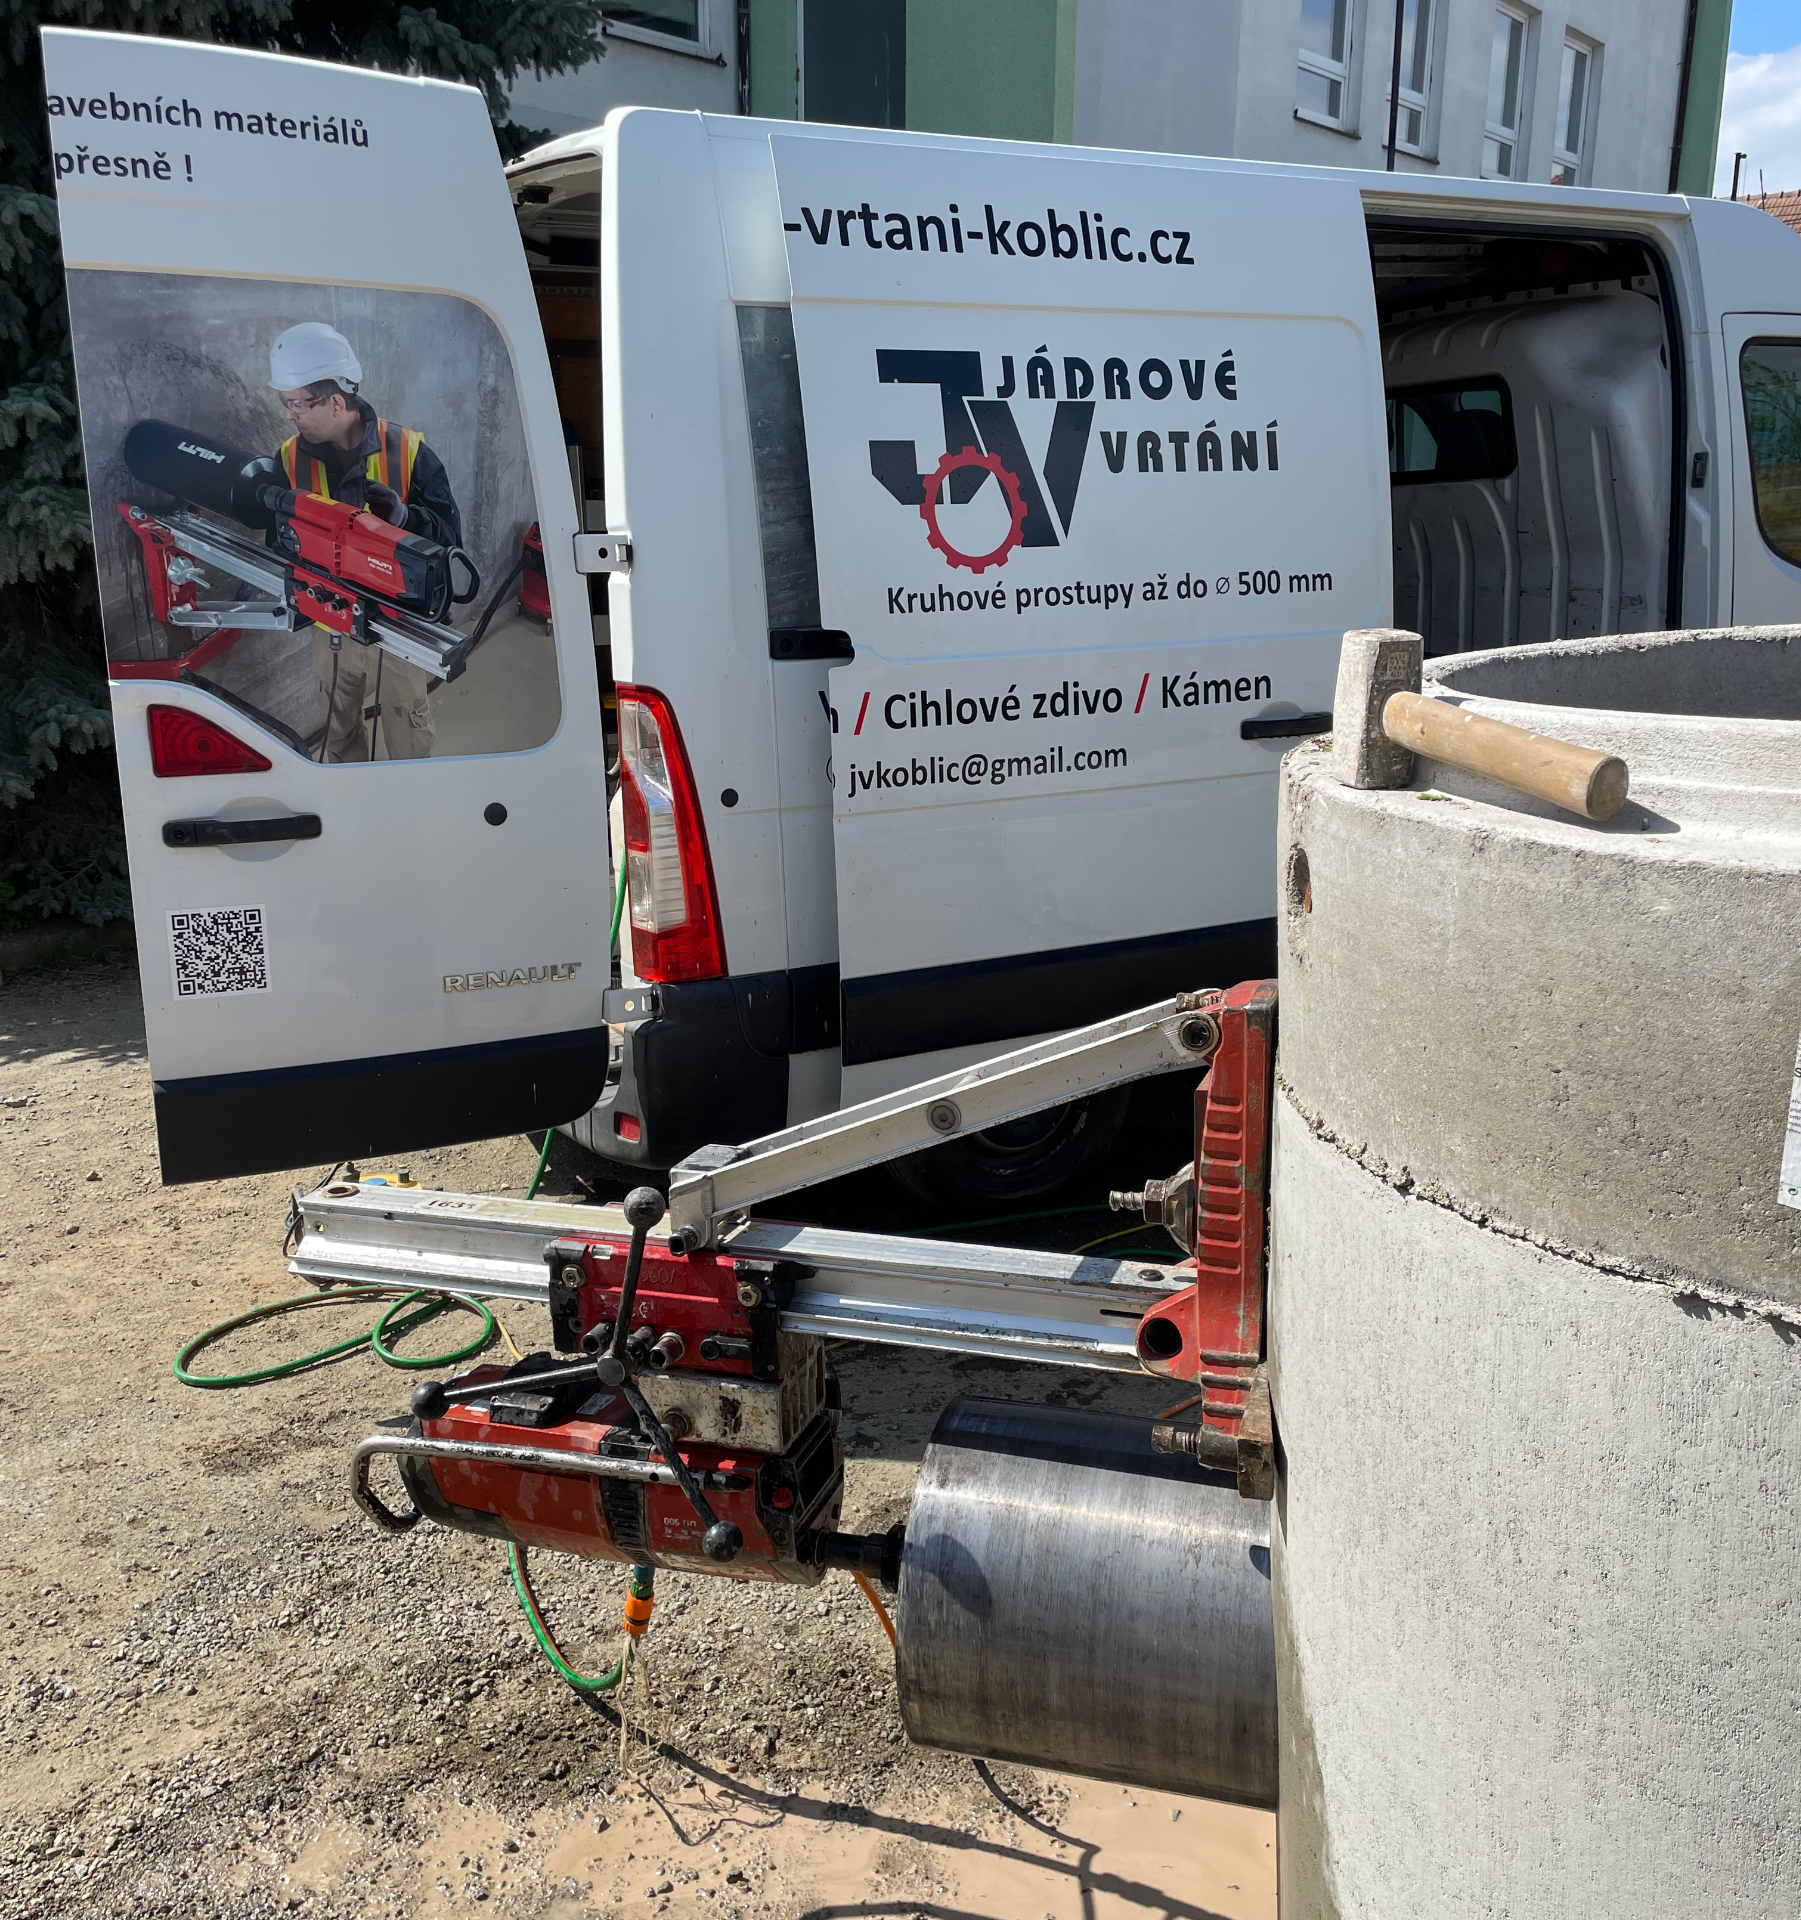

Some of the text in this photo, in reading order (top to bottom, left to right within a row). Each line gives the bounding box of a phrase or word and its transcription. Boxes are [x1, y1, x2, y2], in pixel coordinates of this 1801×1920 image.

[214, 108, 370, 148] materiálů
[54, 145, 194, 183] přesně !
[784, 202, 1196, 266] -vrtani-koblic.cz
[996, 343, 1239, 401] JÁDROVÉ
[1099, 418, 1280, 474] VRTÁNÍ
[887, 581, 1007, 615] Kruhové
[1014, 578, 1135, 615] prostupy
[1141, 573, 1169, 602] až
[1176, 572, 1209, 600] do
[1237, 570, 1281, 597] 500
[1287, 571, 1334, 593] mm
[883, 683, 1022, 731] Cihlové
[1032, 680, 1124, 719] zdivo
[1161, 670, 1273, 710] Kámen
[847, 744, 1128, 798] jvkoblic@gmail.com
[443, 961, 582, 993] RENAULT
